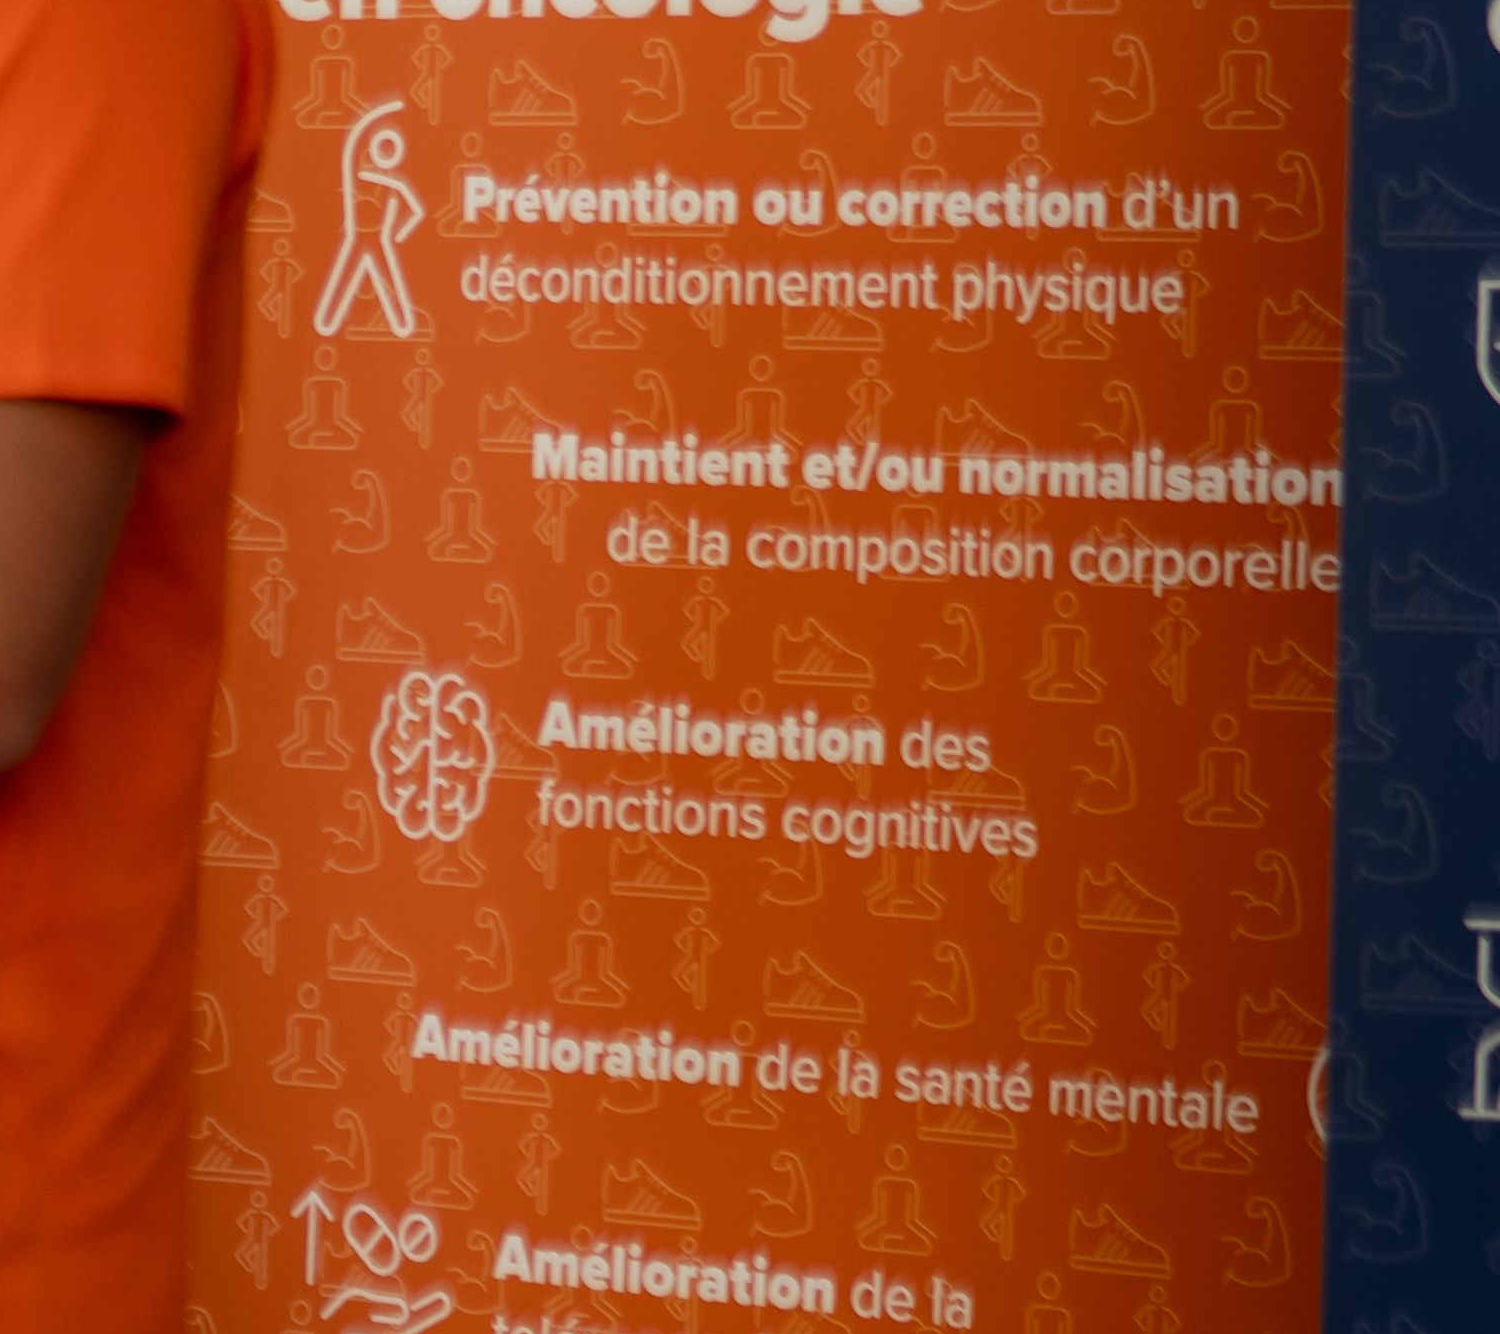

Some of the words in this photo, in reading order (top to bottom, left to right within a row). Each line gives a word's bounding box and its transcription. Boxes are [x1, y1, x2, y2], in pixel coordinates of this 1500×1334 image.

[462, 171, 737, 228] Prévention
[753, 181, 822, 226] ou
[838, 173, 1101, 228] correction
[1121, 177, 1238, 230] d'un
[460, 251, 938, 312] déconditionnement
[953, 262, 1184, 323] physique
[531, 430, 788, 489] Maintient
[803, 439, 944, 496] et/ou
[958, 445, 1344, 506] normalisation
[607, 515, 671, 565] de
[688, 515, 730, 567] la
[747, 521, 1055, 584] composition
[1070, 536, 1342, 595] corporelle
[538, 698, 885, 766] Amélioration
[900, 719, 991, 772] des
[537, 776, 766, 840] fonctions
[781, 787, 1038, 861] cognitives
[411, 1010, 740, 1088] Amélioration
[756, 1038, 821, 1093] de
[837, 1042, 880, 1099] la
[895, 1053, 1033, 1114] santé
[1049, 1067, 1260, 1135] mentale
[494, 1232, 835, 1315] Amélioration
[850, 1268, 914, 1323] de
[931, 1272, 974, 1329] la
